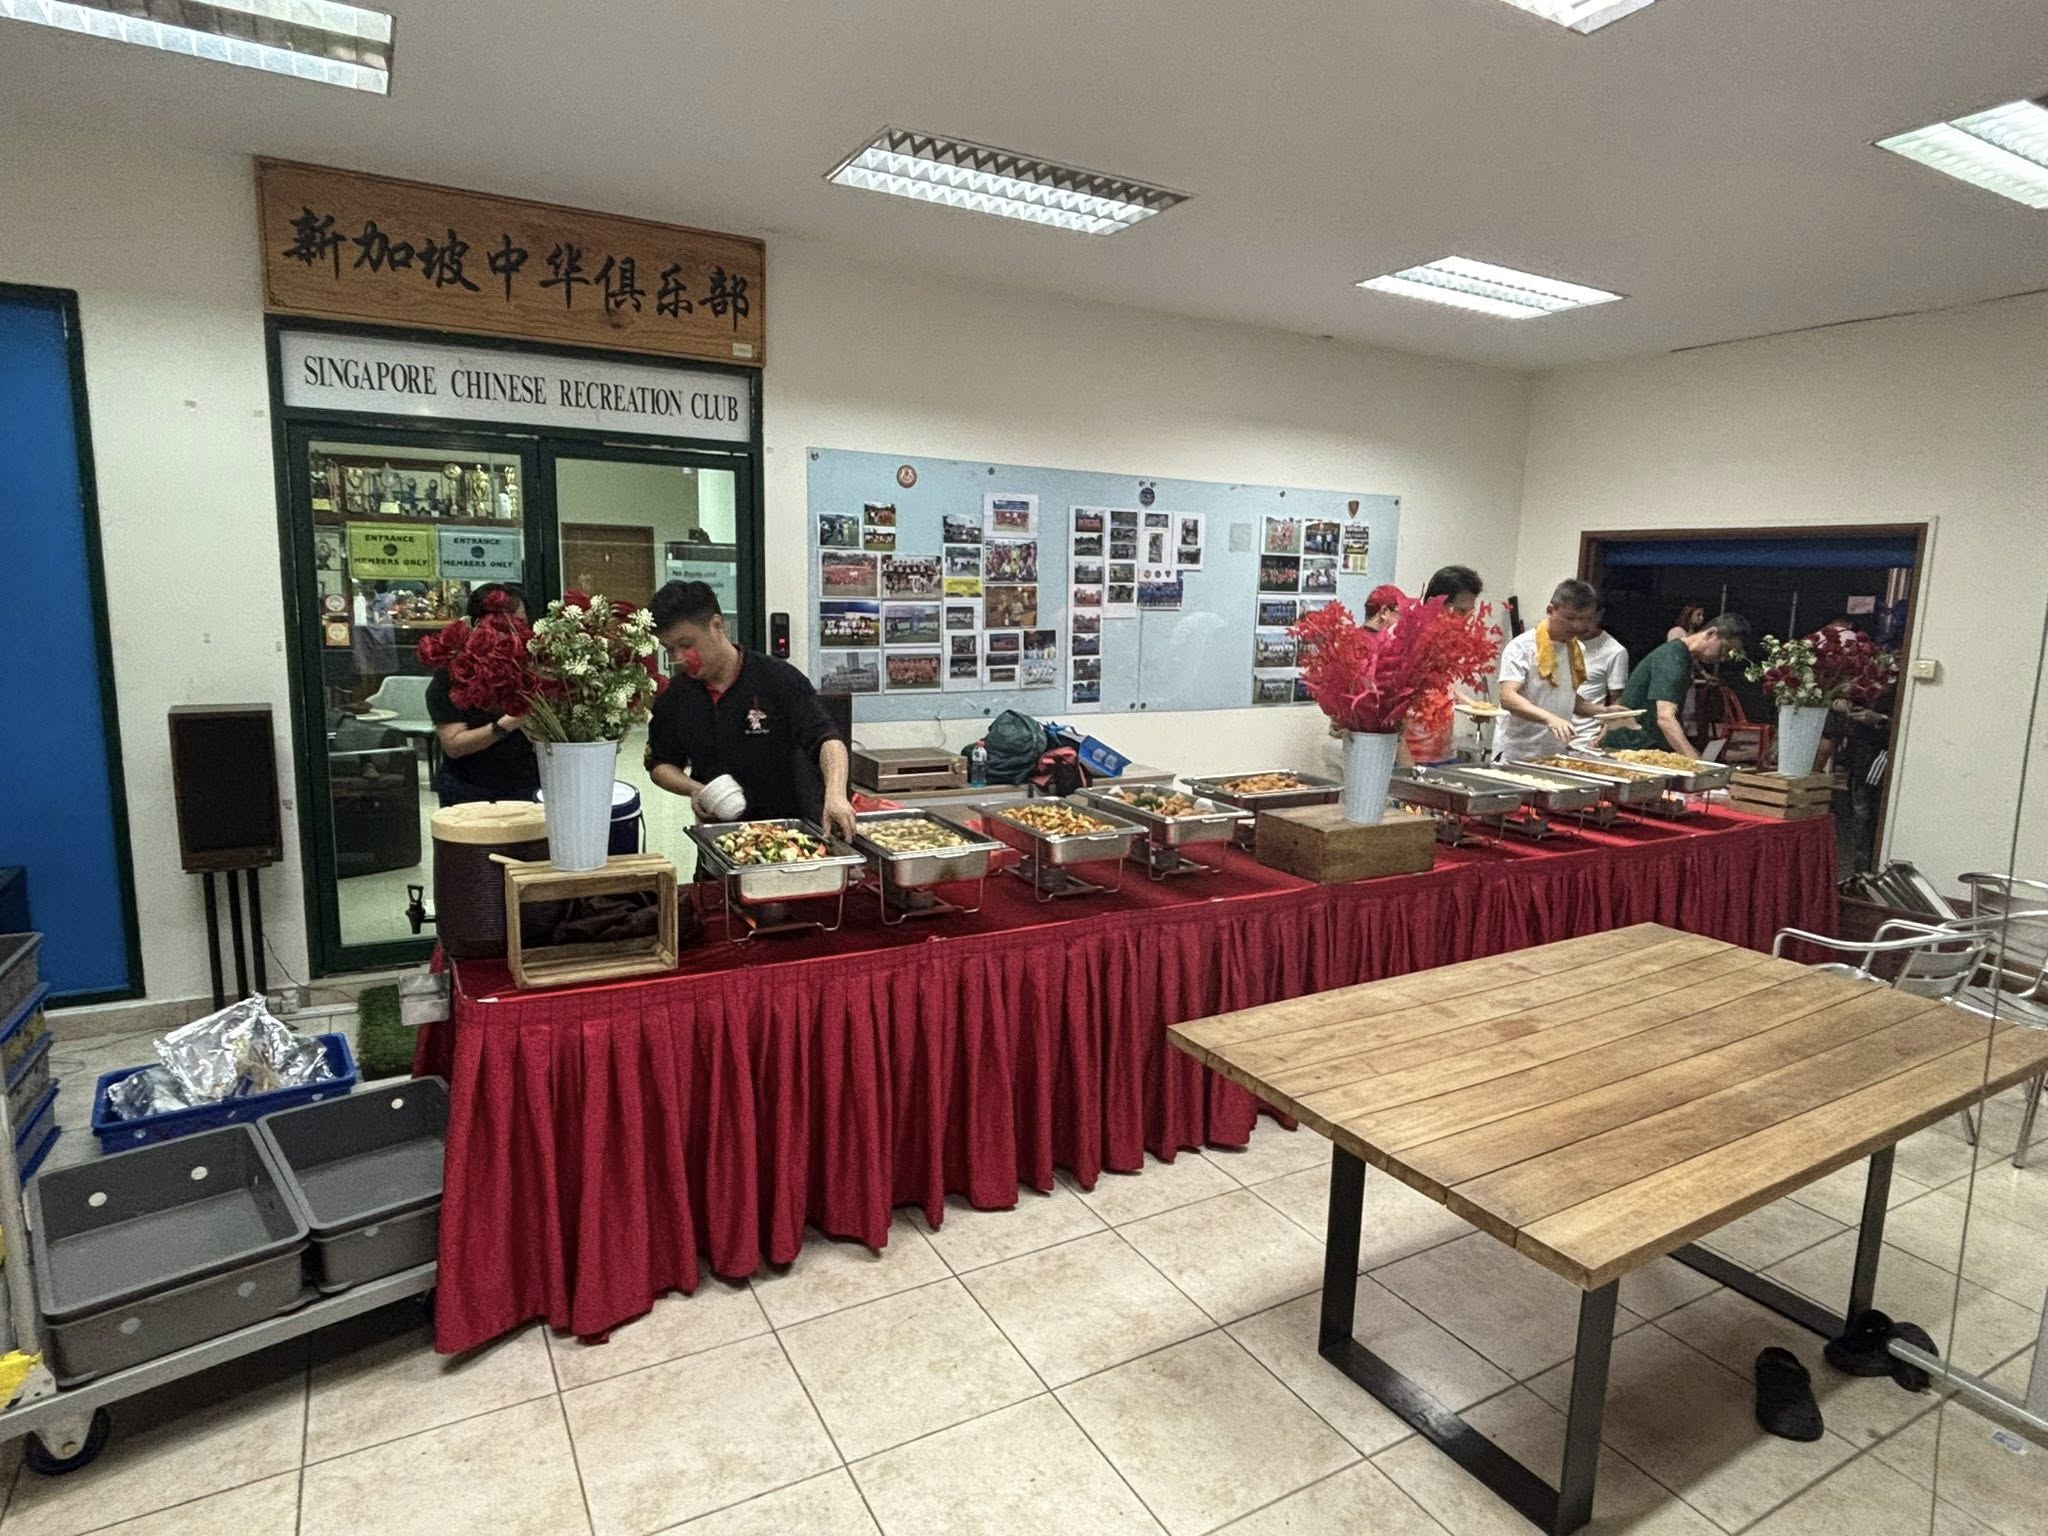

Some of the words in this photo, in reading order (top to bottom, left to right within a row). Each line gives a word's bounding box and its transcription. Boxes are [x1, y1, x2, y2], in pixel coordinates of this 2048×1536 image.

[282, 206, 751, 332] 新加坡中华俱乐部
[303, 354, 437, 395] SINGAPORE
[450, 369, 548, 406] CHINESE
[560, 379, 684, 417] RECREATION
[690, 392, 740, 422] CLUB
[365, 534, 415, 543] ENTRANCE
[453, 537, 501, 546] ENTRANCE
[354, 557, 399, 566] MEMBERS
[403, 558, 428, 567] ONLY
[443, 559, 486, 568] MEMBERS
[490, 560, 514, 569] ONLY
